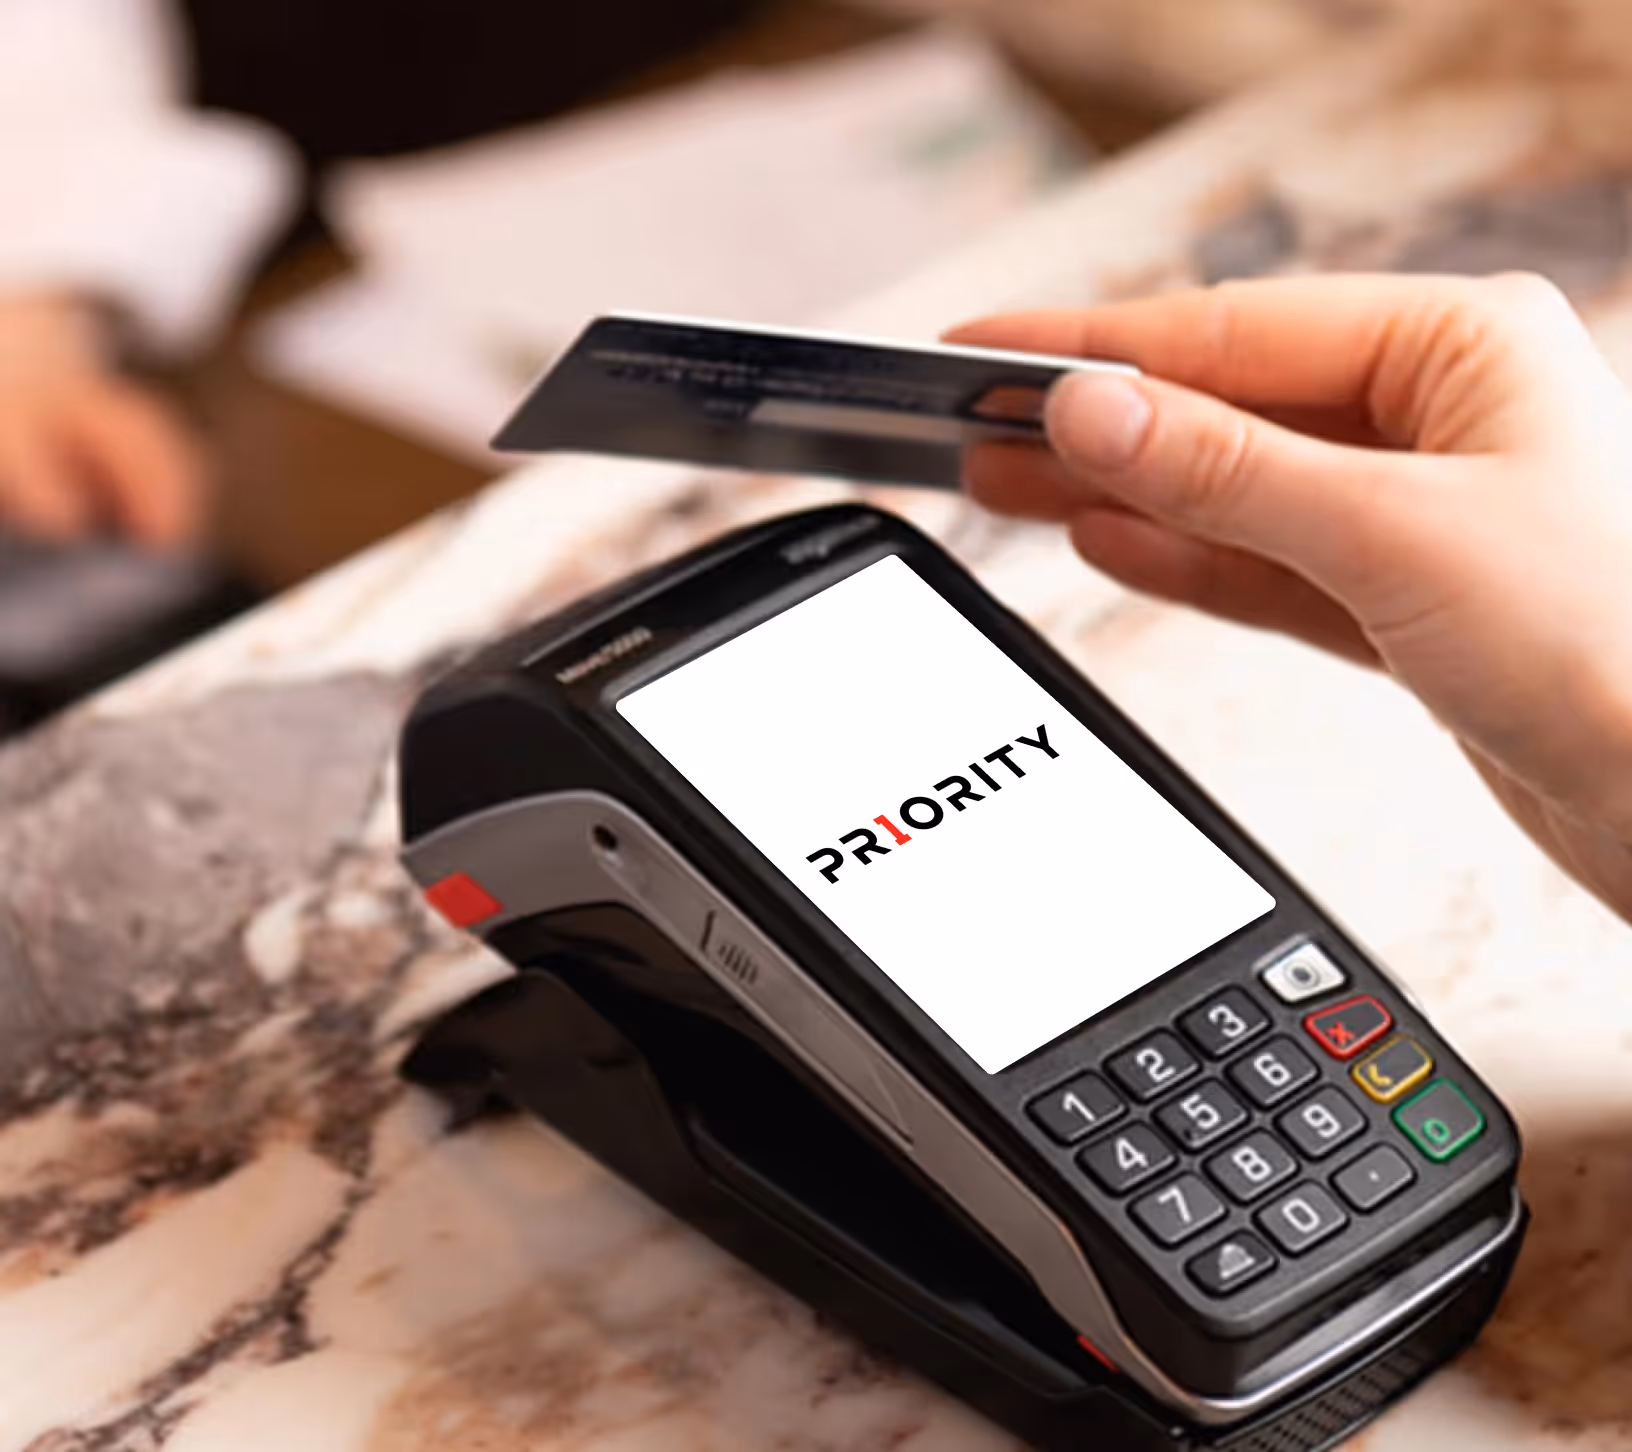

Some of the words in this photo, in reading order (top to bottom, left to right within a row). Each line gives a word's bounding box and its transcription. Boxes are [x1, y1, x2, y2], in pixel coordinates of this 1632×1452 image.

[1062, 1092, 1096, 1121] 1
[1136, 1048, 1176, 1082] 2
[1208, 1004, 1246, 1038] 3
[1114, 1137, 1148, 1169] 4
[1180, 1094, 1220, 1129] 5
[1253, 1052, 1291, 1087] 6
[1157, 1186, 1192, 1223] 7
[1231, 1145, 1272, 1182] 8
[1302, 1103, 1341, 1138] 9
[1281, 1198, 1321, 1233] 0
